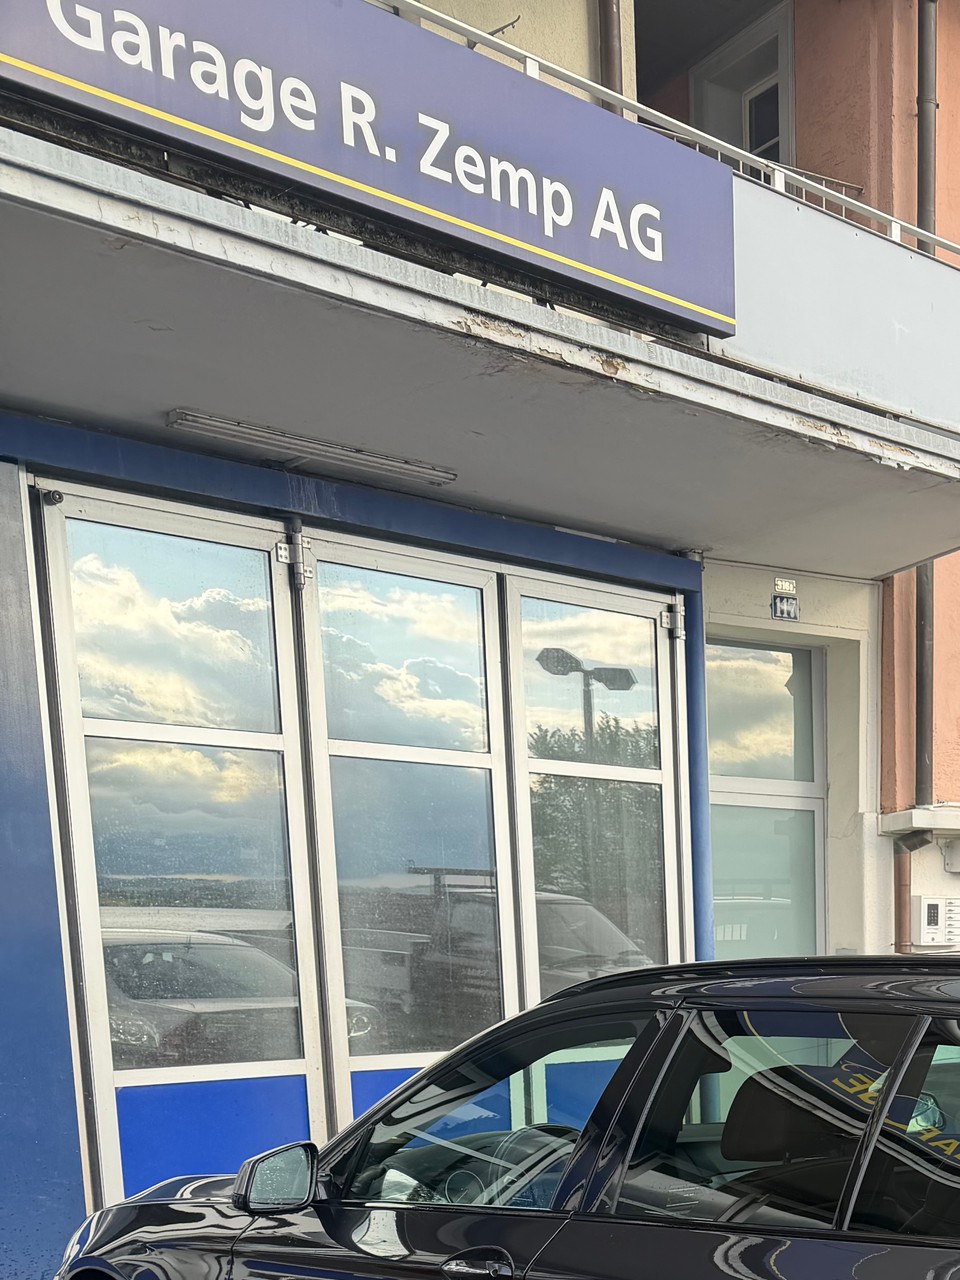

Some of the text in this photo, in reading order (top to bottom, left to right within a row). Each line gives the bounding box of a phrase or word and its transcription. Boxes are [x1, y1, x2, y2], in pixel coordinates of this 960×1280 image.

[46, 0, 664, 262] Garage R. Zemp AG
